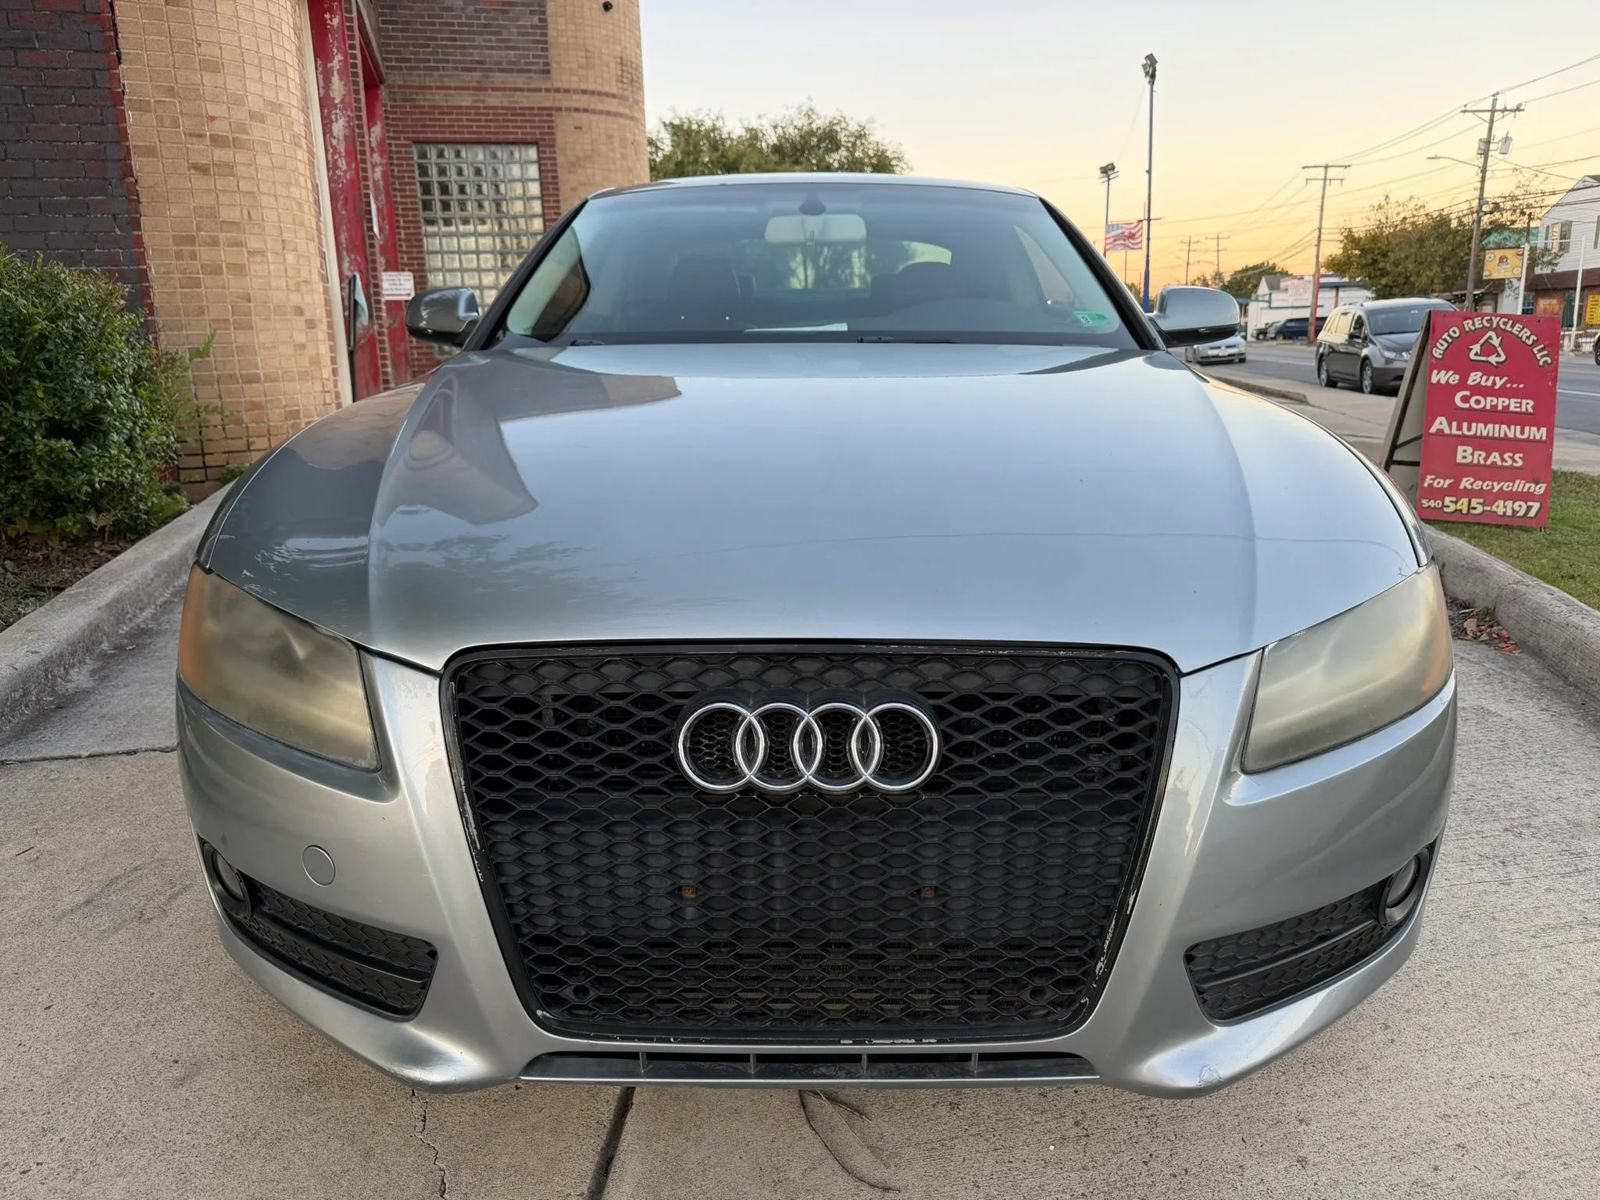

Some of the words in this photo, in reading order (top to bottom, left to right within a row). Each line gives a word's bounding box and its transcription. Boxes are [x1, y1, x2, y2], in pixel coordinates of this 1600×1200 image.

[1432, 326, 1461, 359] AUTO
[1463, 316, 1537, 346] RECYCLERS
[1532, 344, 1553, 367] LLC
[1431, 369, 1460, 385] We
[1467, 371, 1524, 389] Buy...
[1455, 391, 1535, 413] COPPER
[1429, 416, 1547, 441] ALUMINUM
[1456, 445, 1524, 467] BRASS
[1423, 475, 1454, 489] For
[1459, 476, 1548, 495] Recycling
[1421, 499, 1442, 509] 540
[1442, 496, 1541, 518] 545-4197
